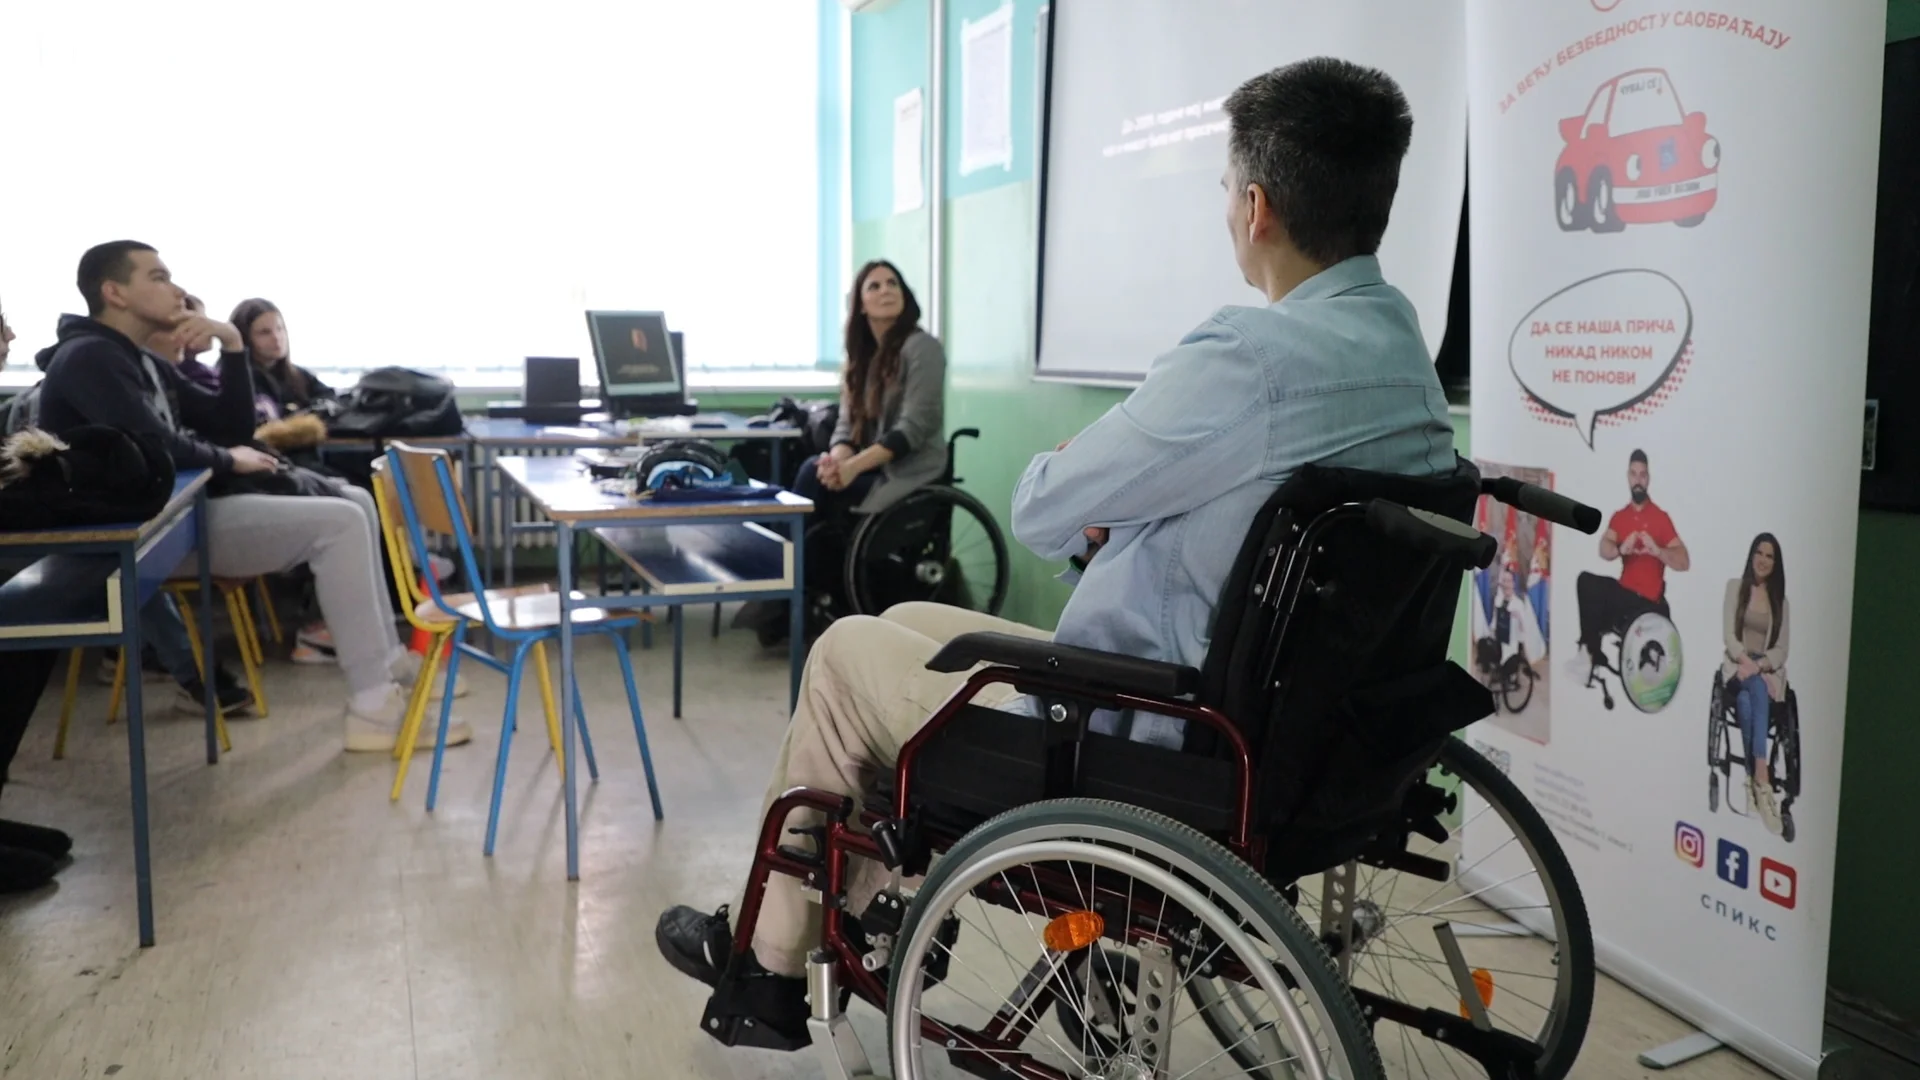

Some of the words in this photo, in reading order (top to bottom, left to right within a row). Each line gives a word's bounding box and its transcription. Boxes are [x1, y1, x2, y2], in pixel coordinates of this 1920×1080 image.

[1516, 58, 1553, 96] ВЕЋУ
[1556, 14, 1657, 66] БЕЗБЕДНОСТ
[1659, 12, 1671, 28] У
[1673, 10, 1791, 50] САОБРАЋАЈУ
[1530, 321, 1551, 336] ДА
[1555, 321, 1573, 334] СЕ
[1577, 320, 1622, 334] НАША
[1626, 319, 1676, 334] ПРИЧА
[1545, 346, 1596, 360] НИКАД
[1600, 345, 1653, 360] НИКОМ
[1552, 370, 1571, 383] НЕ
[1575, 370, 1636, 385] ПОНОВИ
[1701, 893, 1777, 941] СПИКС
